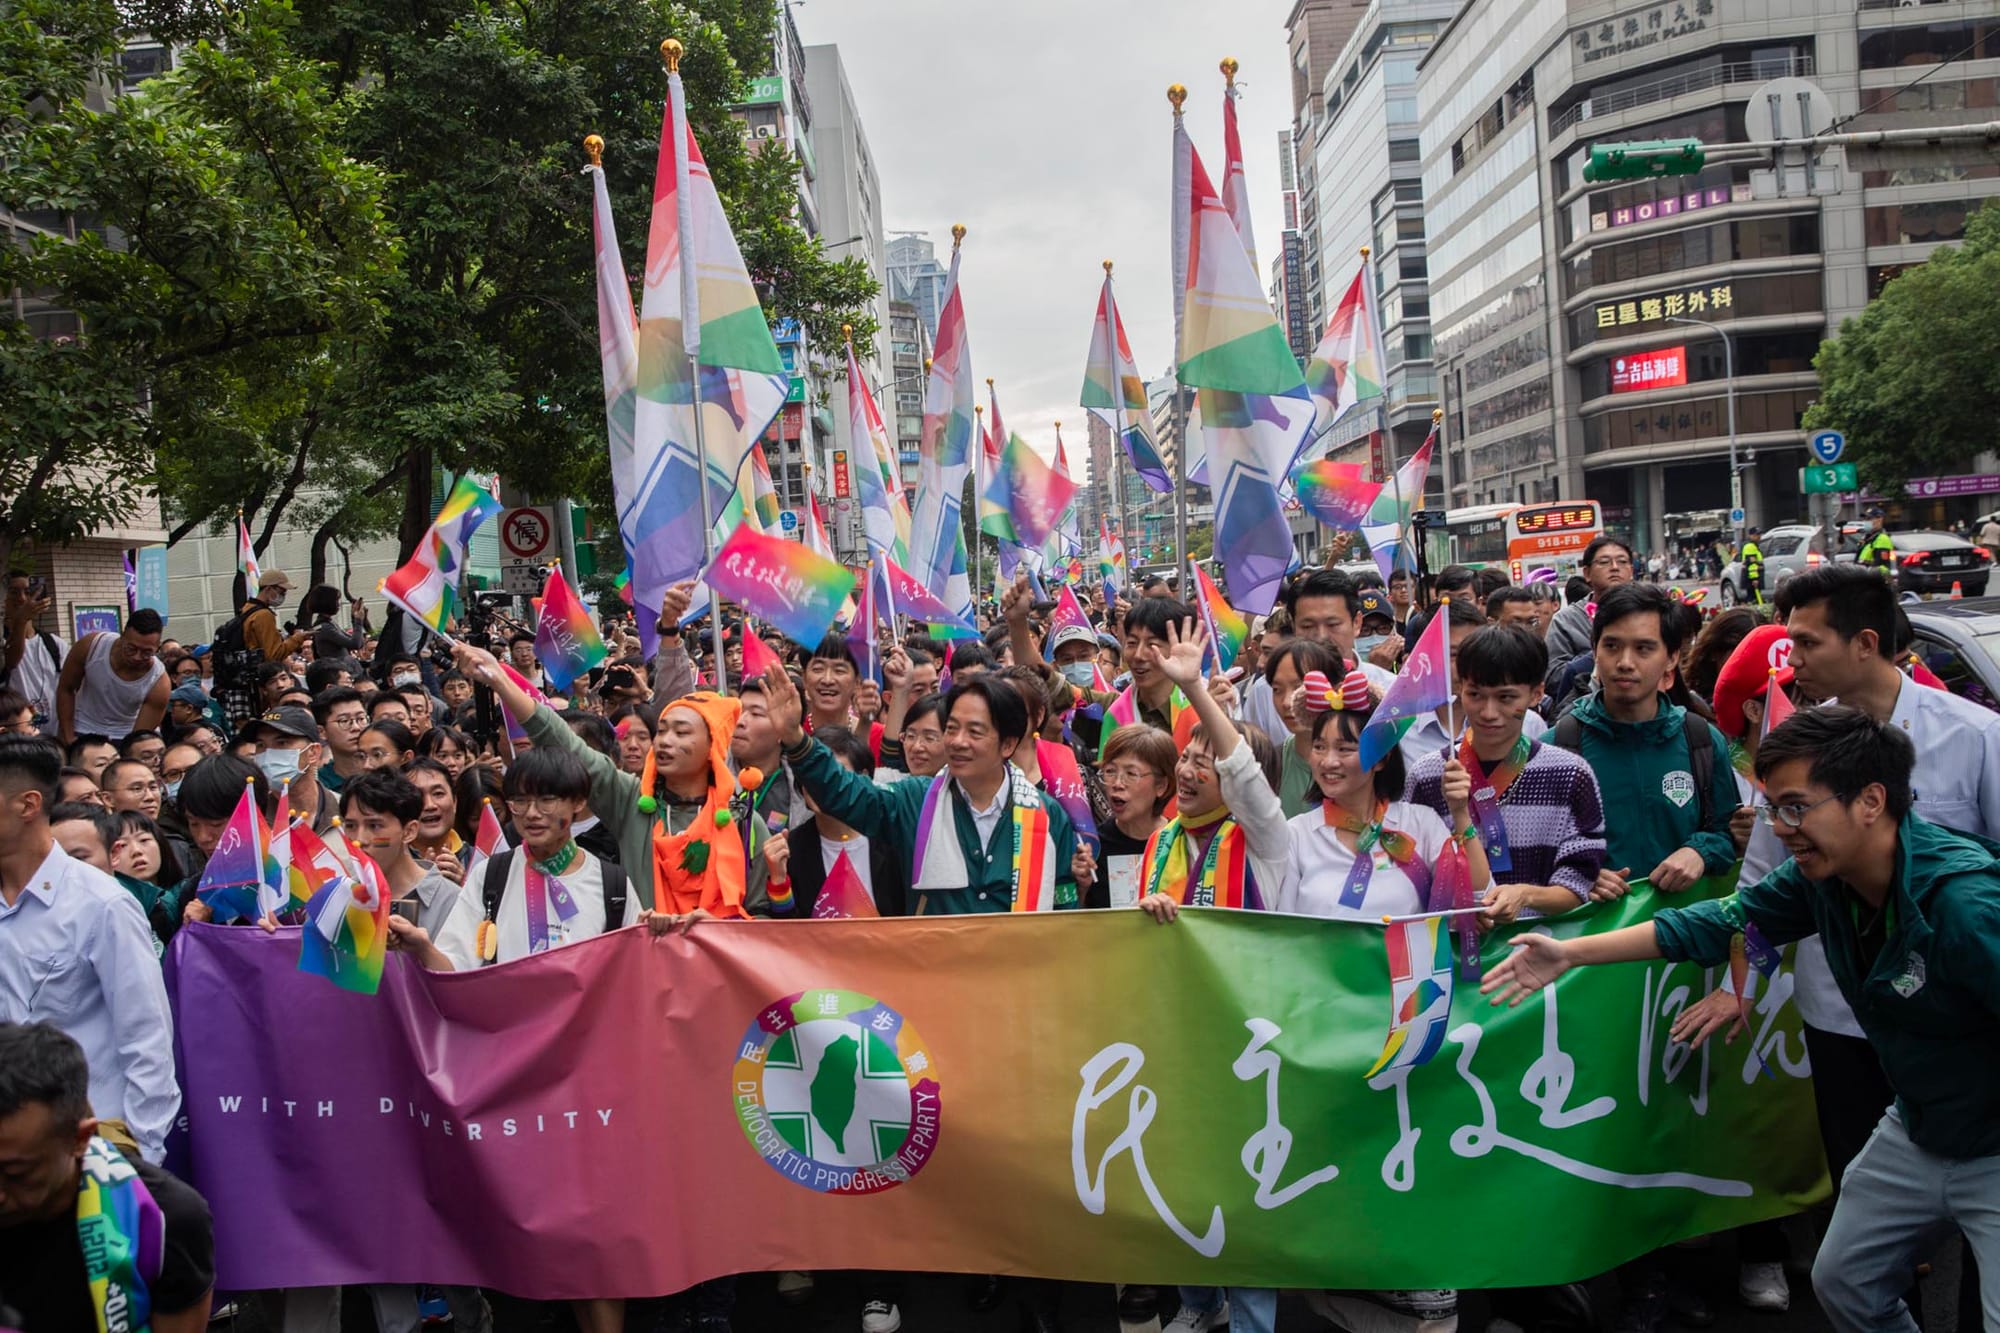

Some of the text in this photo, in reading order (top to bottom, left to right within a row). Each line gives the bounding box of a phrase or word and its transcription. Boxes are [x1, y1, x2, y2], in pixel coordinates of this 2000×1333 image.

[1663, 19, 1706, 40] PLAZA
[1617, 190, 1721, 225] HOTEL
[1596, 286, 1733, 328] 巨星整形外科
[1822, 437, 1836, 454] 5
[1824, 470, 1837, 486] 3
[505, 519, 539, 546] 停
[1537, 535, 1582, 549] 918-FR
[219, 1096, 613, 1141] WITH DIVERSITY
[737, 1081, 936, 1191] DEMOCRATIC PROGRESSIVE PARTY
